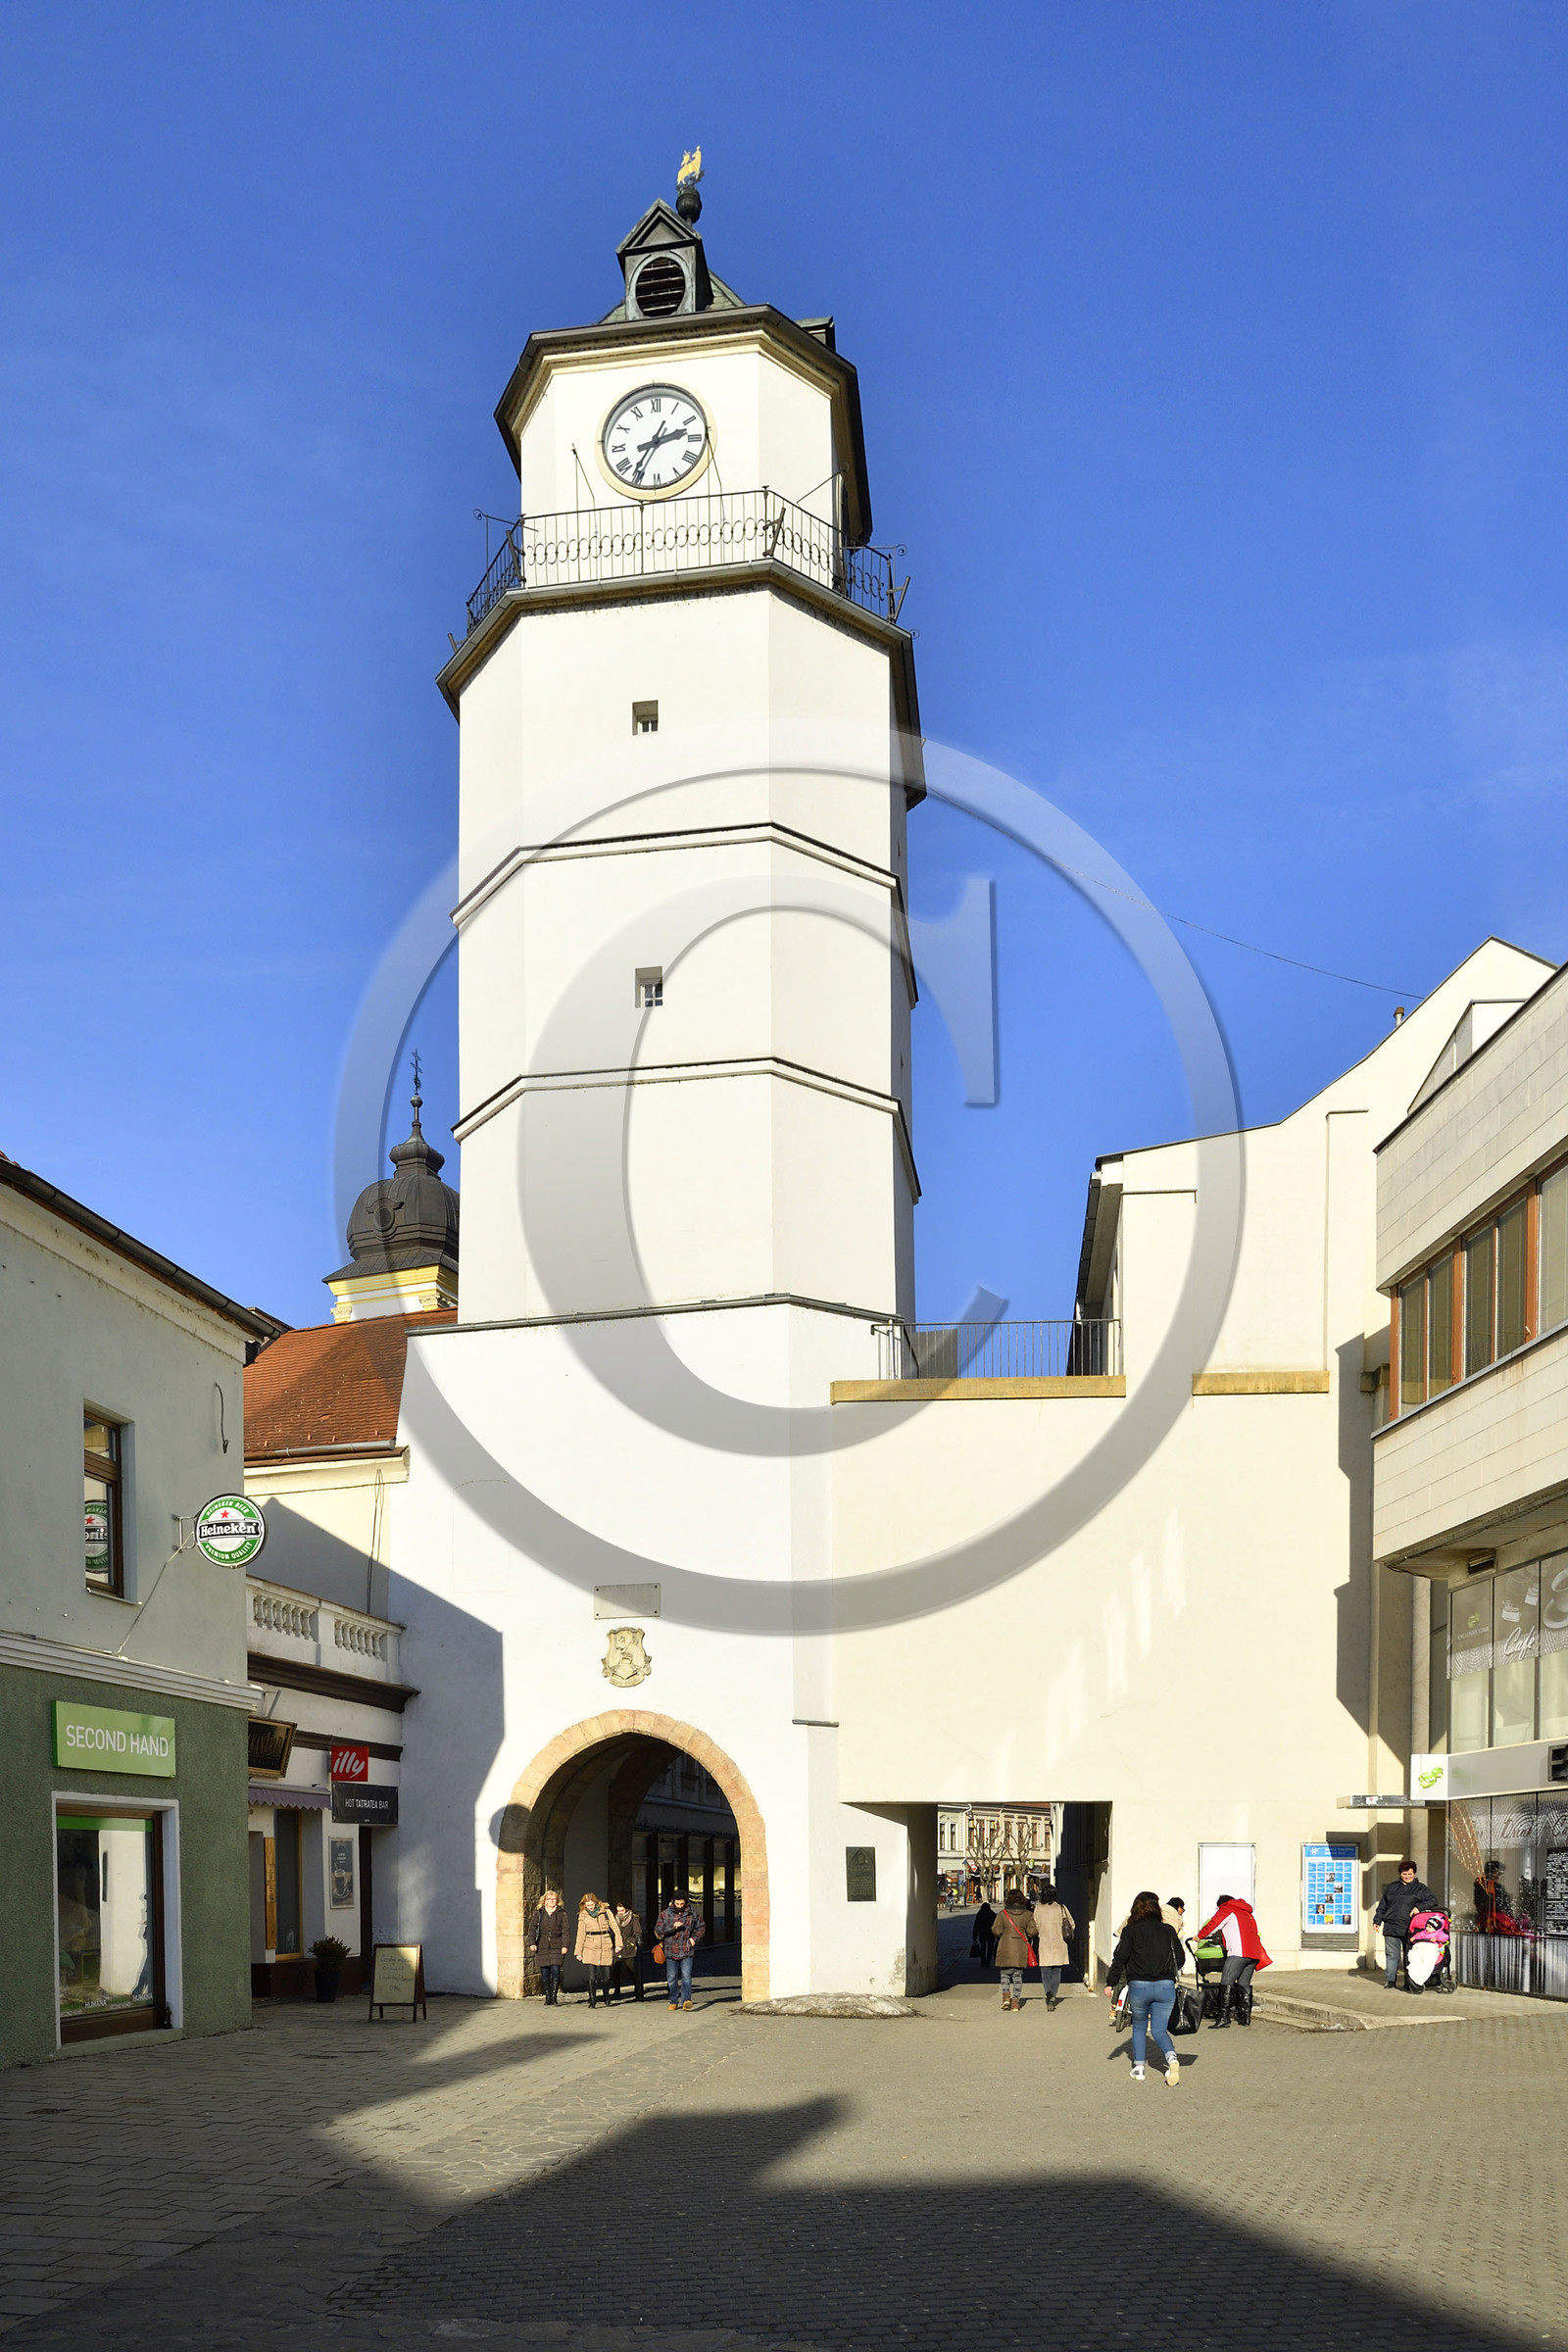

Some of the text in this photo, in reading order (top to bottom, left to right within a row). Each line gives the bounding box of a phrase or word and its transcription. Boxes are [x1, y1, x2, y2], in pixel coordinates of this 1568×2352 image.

[200, 1522, 256, 1538] Heineken
[205, 1542, 253, 1560] PREMIUM QUALITY
[66, 1725, 169, 1757] SECOND HAND
[333, 1750, 366, 1779] illy
[345, 1798, 389, 1810] HOT TATRATEA BAR
[84, 1999, 108, 2008] HUMANA
[132, 1992, 153, 2001] HUMANA
